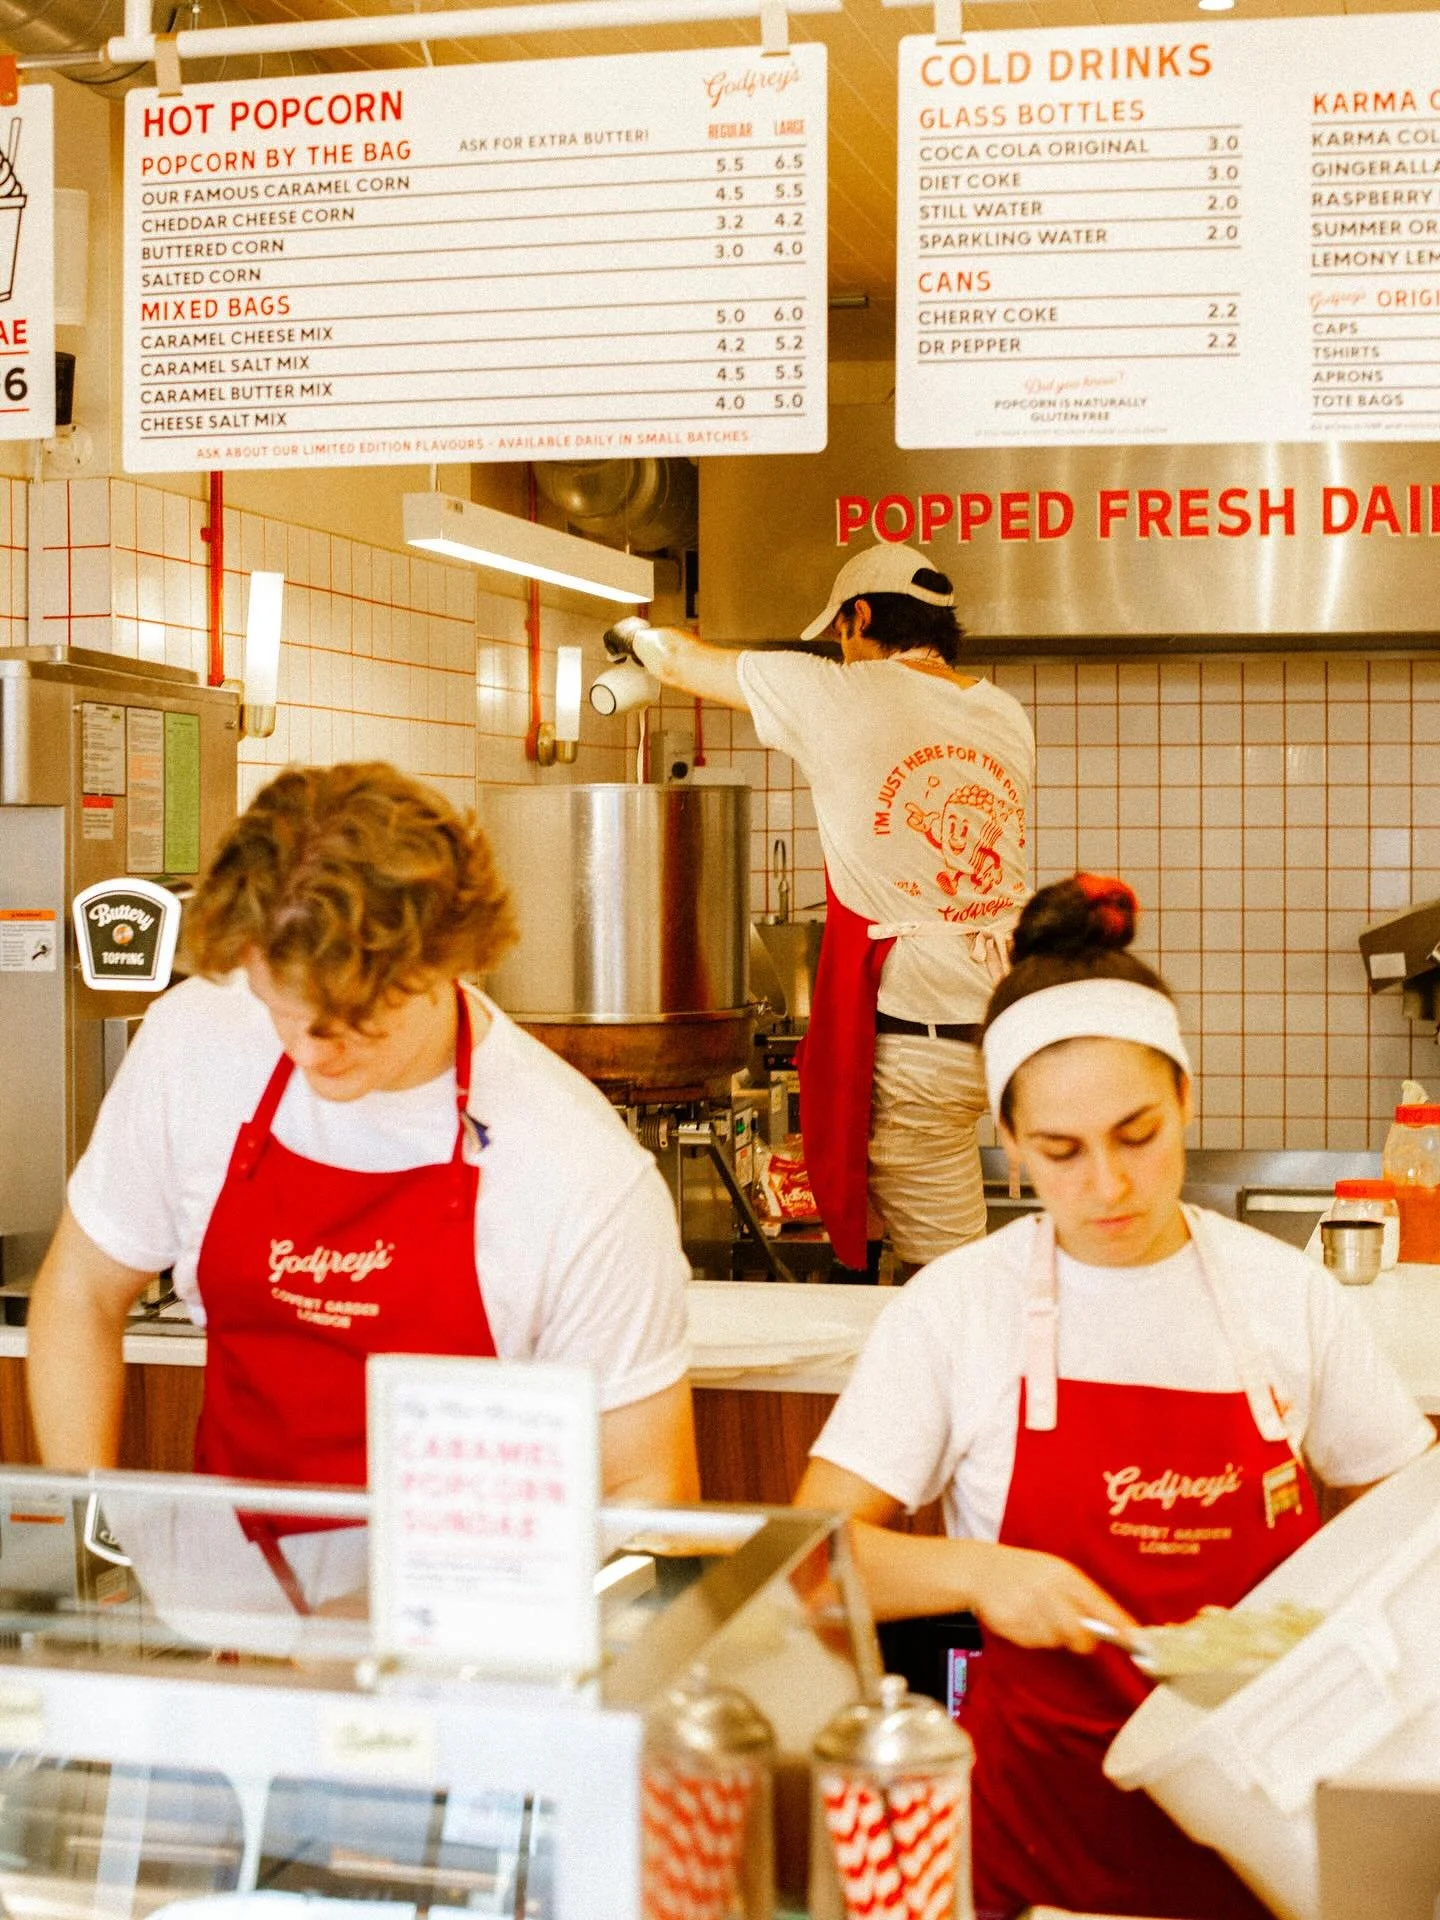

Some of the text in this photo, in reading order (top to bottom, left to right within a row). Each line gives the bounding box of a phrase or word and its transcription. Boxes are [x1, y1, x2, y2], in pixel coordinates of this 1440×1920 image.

[920, 43, 1213, 88] COLD DRINKS
[702, 61, 800, 109] Godfrey's
[144, 91, 402, 137] HOT POPCORN
[920, 99, 1145, 130] GLASS BOTTLES
[1313, 91, 1417, 114] KARMA
[708, 118, 806, 139] REGULAR LARGE
[1311, 130, 1391, 147] KARMA
[459, 138, 487, 151] ASK
[494, 137, 522, 149] FOR
[528, 133, 577, 148] EXTRA
[920, 136, 1238, 162] COCA COLA ORIGINAL 3.0
[142, 140, 412, 176] POPCORN BY THE BAG
[142, 154, 803, 206] OUR FAMOUS CARAMEL CORN 5.5 6.5
[920, 166, 1238, 192] DIET COKE 3.0
[142, 183, 803, 234] CHEDDAR CHEESE CORN 4.5 5.5
[920, 195, 1238, 220] STILL WATER 2.0
[1311, 189, 1432, 207] RASPBERRY
[142, 212, 803, 260] BUTTERED CORN 3.2 4.2
[920, 225, 1238, 249] SPARKLING WATER 2.0
[1311, 220, 1401, 237] SUMMER
[142, 241, 803, 287] SALTED CORN 3.0 4.0
[1311, 251, 1399, 268] LEMONY
[918, 271, 991, 293] CANS
[141, 295, 291, 321] MIXED BAGS
[919, 303, 1238, 326] CHERRY COKE 2.2
[141, 306, 803, 349] CARAMEL CHEESE MIX 5.0 6.0
[1312, 322, 1359, 335] CAPS
[141, 336, 803, 377] CARAMEL SALT MIX 4.2 5.2
[919, 333, 1237, 355] DR PEPPER 2.2
[1312, 346, 1380, 360] TSHIRTS
[141, 365, 803, 404] CARAMEL BUTTER MIX 4.5 5.5
[1312, 370, 1384, 383] APRONS
[141, 394, 803, 431] CHEESE SALT MIX 4.0 5.0
[994, 397, 1148, 410] POPCORN IS NATURALLY
[1312, 394, 1404, 408] TOTE BAGS
[1030, 410, 1110, 422] GLUTEN FREE
[197, 448, 221, 458] ASK
[226, 446, 268, 458] ABOUT
[273, 445, 299, 456] OUR
[303, 443, 355, 455] LIMITED
[360, 441, 411, 453] EDITION
[416, 438, 484, 451] FLAVOURS
[499, 435, 571, 449] AVAILABLE
[576, 434, 614, 447] DAILY
[619, 433, 632, 445] IN
[638, 432, 683, 445] SMALL
[688, 430, 749, 443] BATCHES
[836, 491, 1074, 546] POPPED
[1098, 487, 1295, 542] FRESH
[874, 745, 1006, 836] I'M JUST HERE FOR THE
[88, 902, 155, 932] Buttery
[102, 951, 144, 966] TOPPING
[268, 1239, 396, 1284] Godfrey's
[1102, 1462, 1243, 1516] Godfrey's
